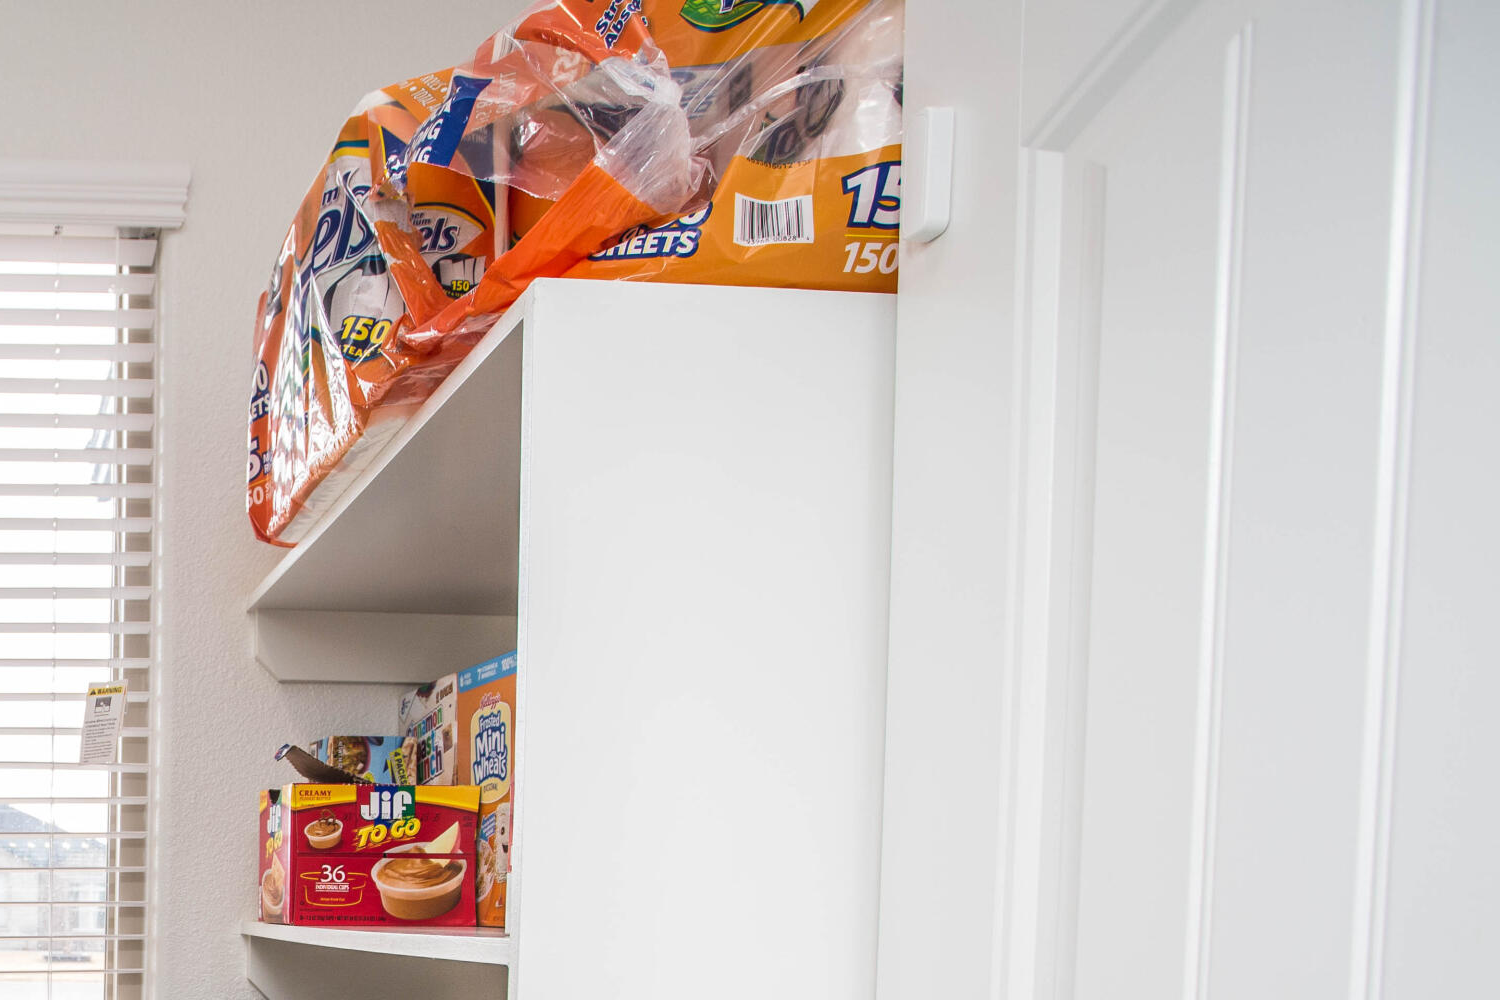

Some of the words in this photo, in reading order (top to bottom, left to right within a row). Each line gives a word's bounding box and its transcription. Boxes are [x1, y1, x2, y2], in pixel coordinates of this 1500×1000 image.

[451, 279, 470, 293] 150
[340, 316, 392, 345] 150
[475, 725, 506, 762] Mini
[473, 746, 508, 785] Wheats
[299, 789, 332, 798] CREAMY
[360, 790, 413, 821] Jif
[356, 824, 388, 848] TO
[389, 817, 422, 839] GO
[320, 864, 346, 883] 36
